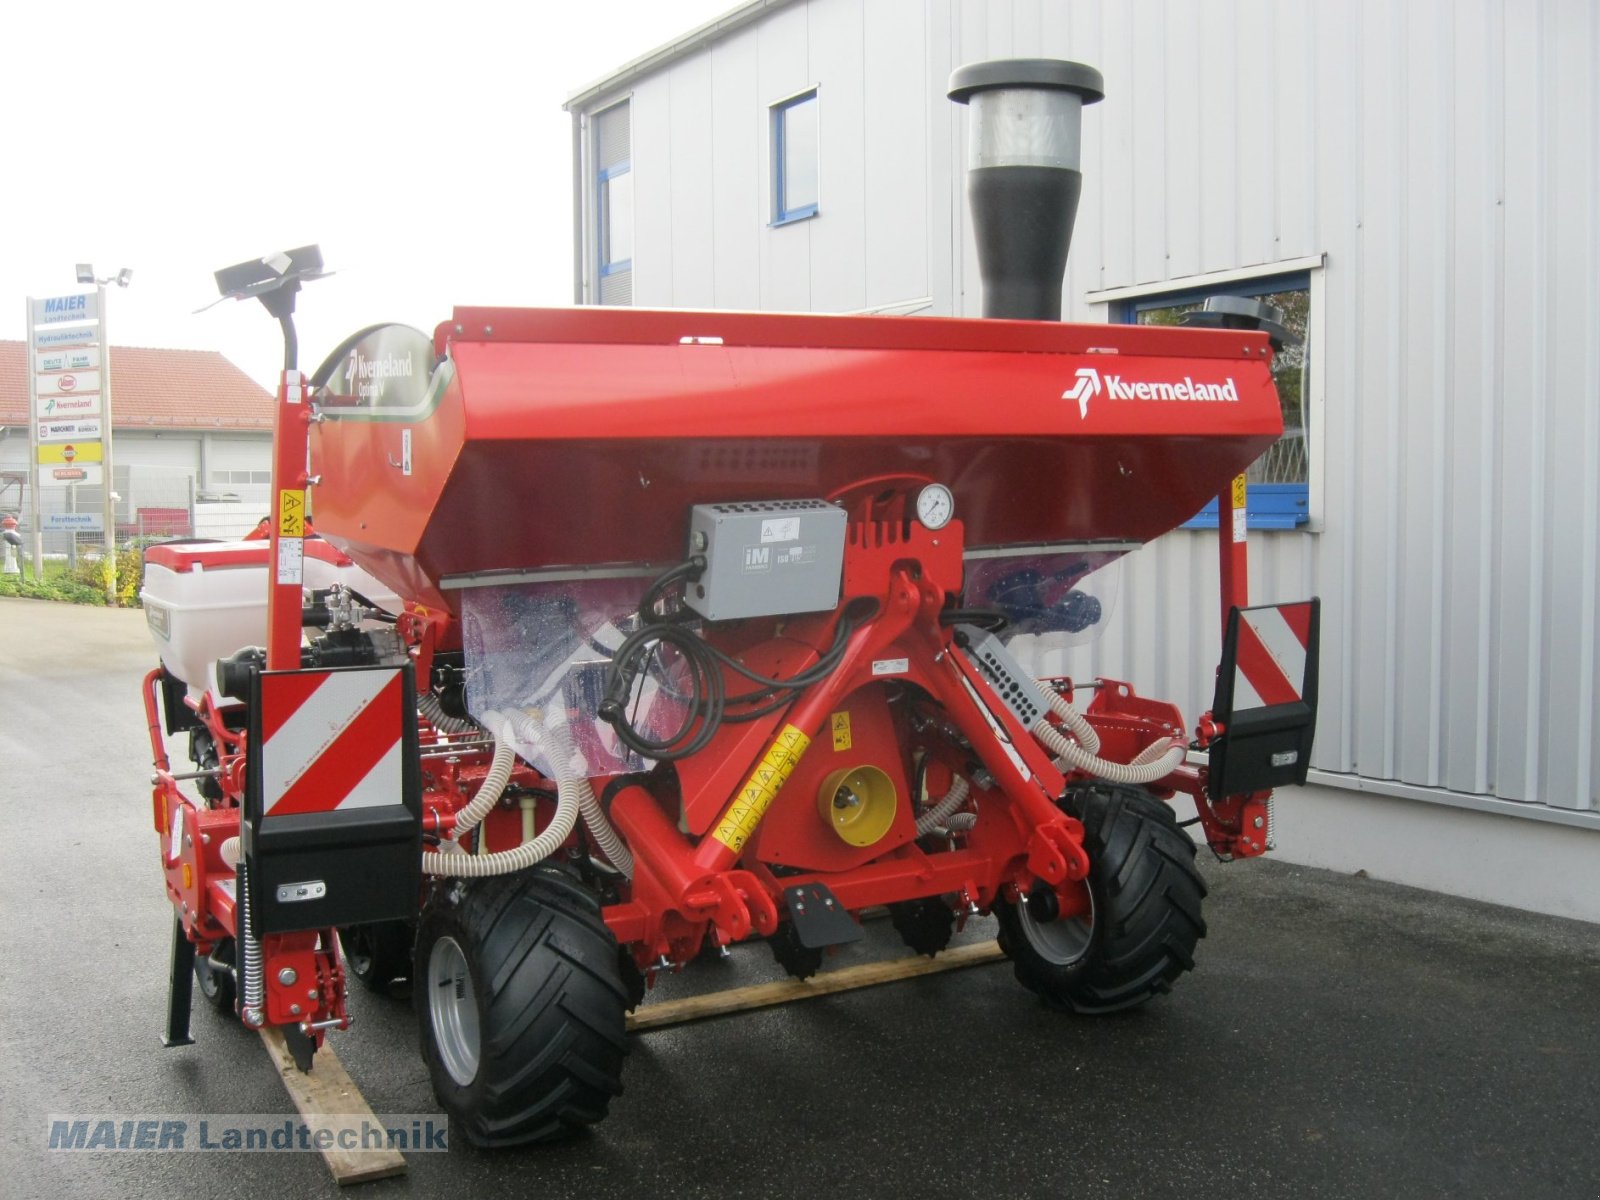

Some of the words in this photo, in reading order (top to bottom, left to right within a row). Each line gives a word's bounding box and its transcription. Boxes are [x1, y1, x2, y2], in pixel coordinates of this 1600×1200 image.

[45, 295, 86, 312] MAIER
[44, 313, 86, 323] Landtechnik
[358, 351, 412, 379] Kverneland
[1104, 375, 1239, 401] Kverneland
[56, 400, 92, 409] Kverneland
